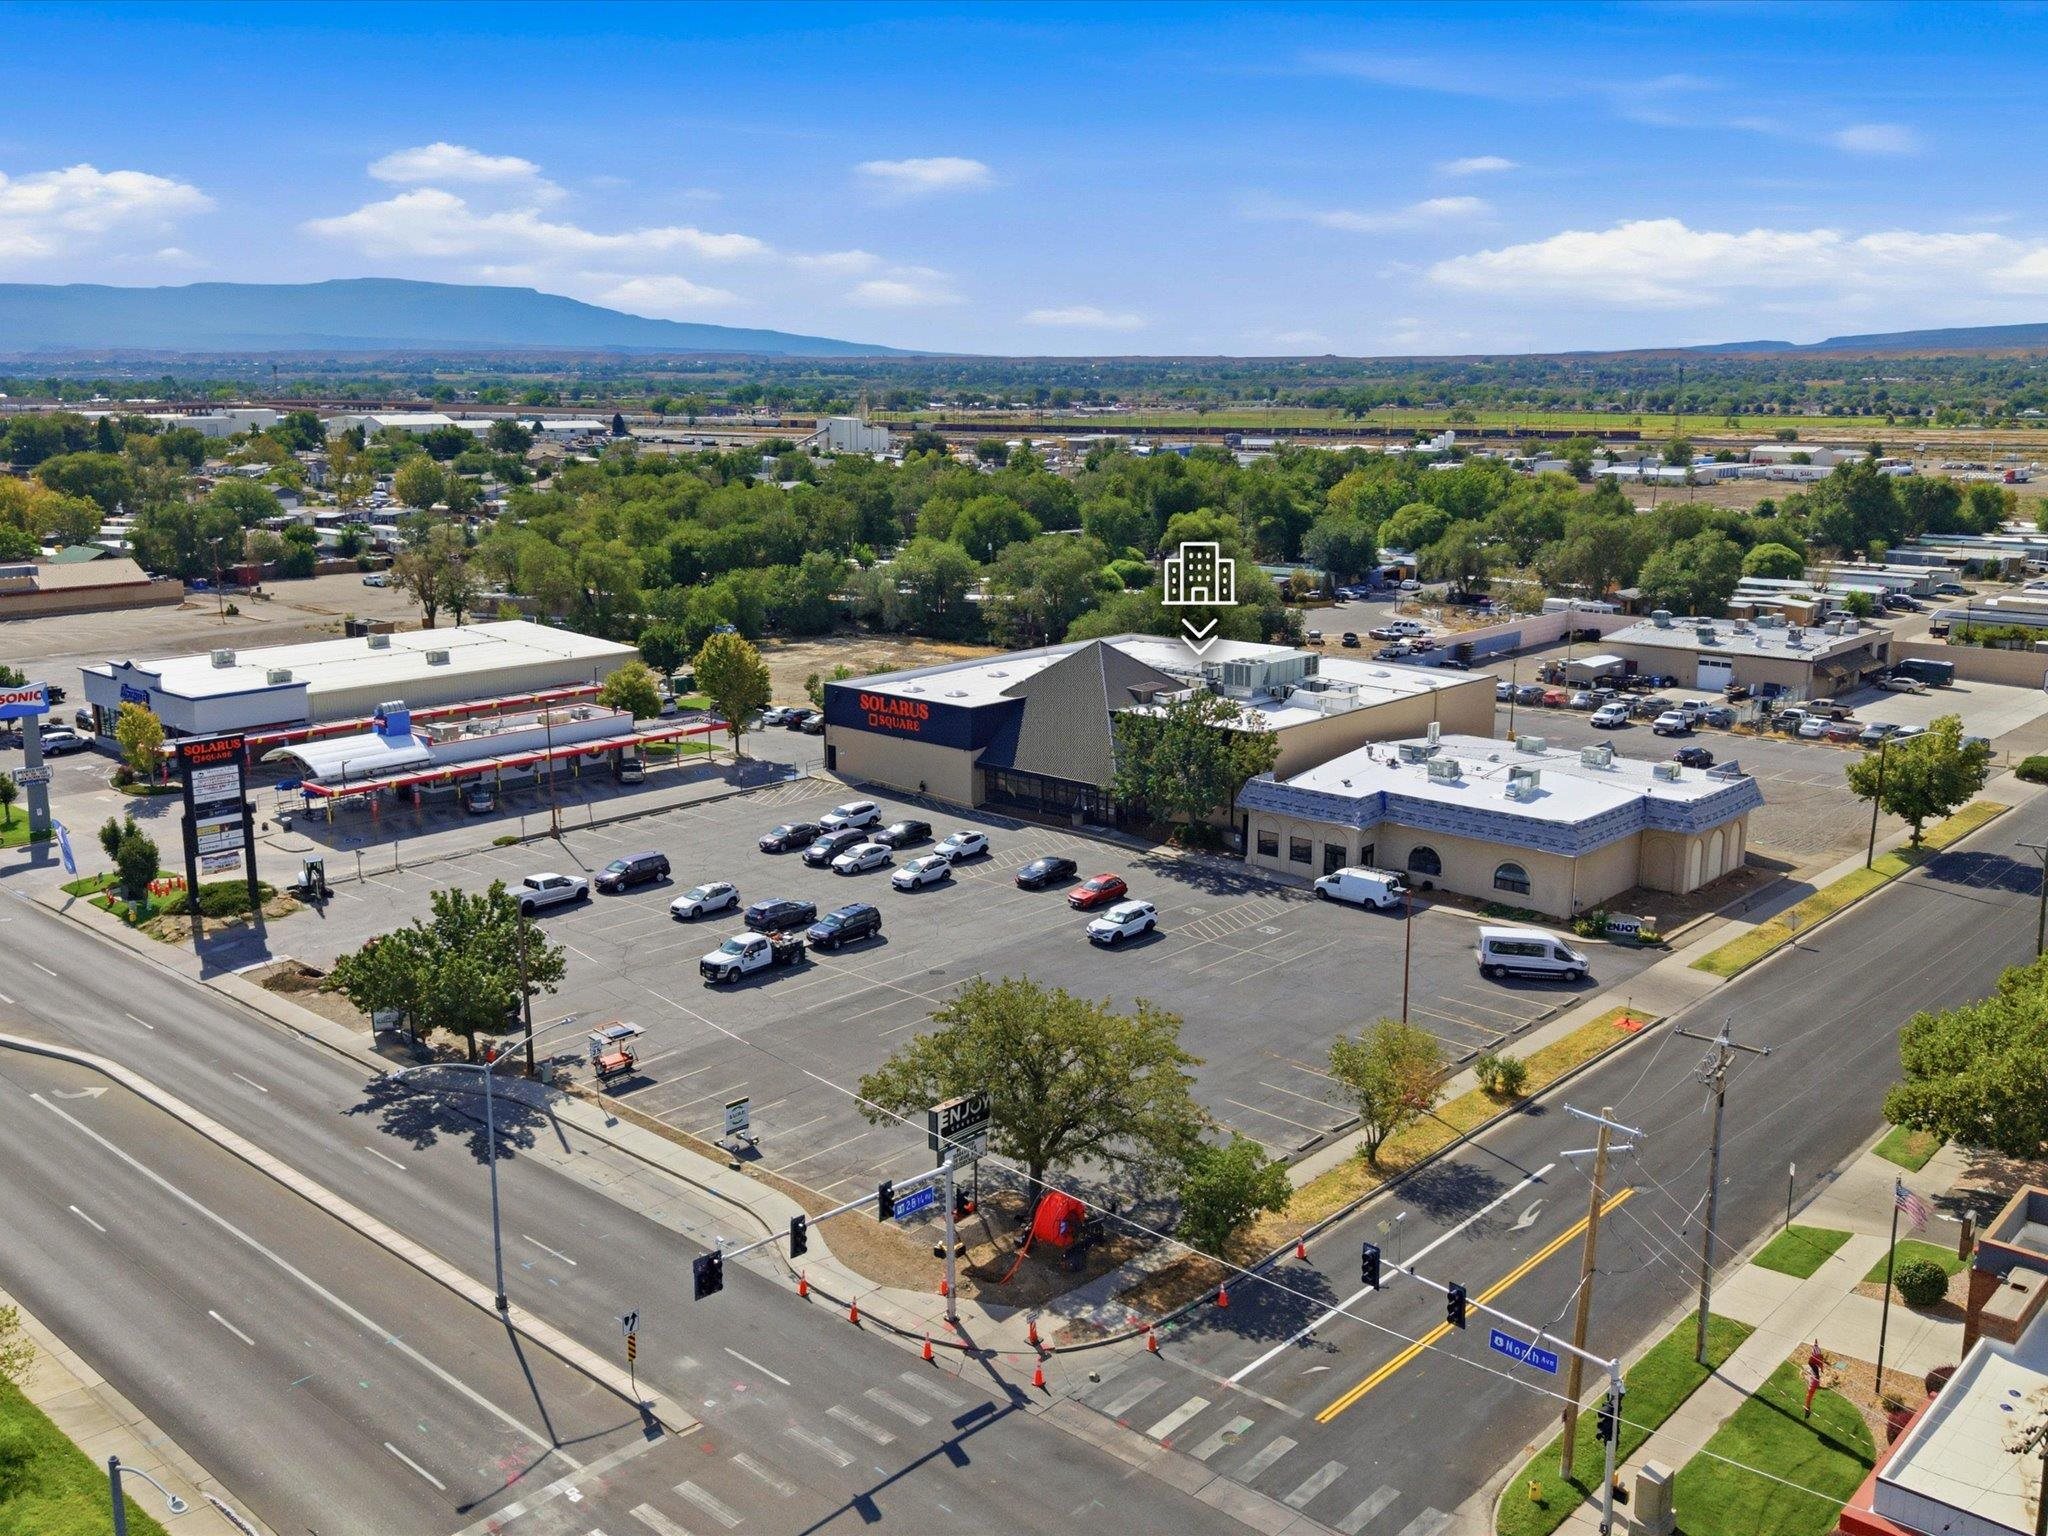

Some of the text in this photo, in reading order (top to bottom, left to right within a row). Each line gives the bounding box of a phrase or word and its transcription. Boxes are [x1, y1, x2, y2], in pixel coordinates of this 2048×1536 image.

[0, 690, 42, 704] SONIC
[860, 694, 928, 719] SOLARUS
[879, 715, 919, 731] SQUARE
[184, 738, 241, 756] SOLARUS
[1607, 922, 1639, 933] ENJOY
[940, 1096, 989, 1127] ENJOY
[1505, 1340, 1554, 1367] North Ave
